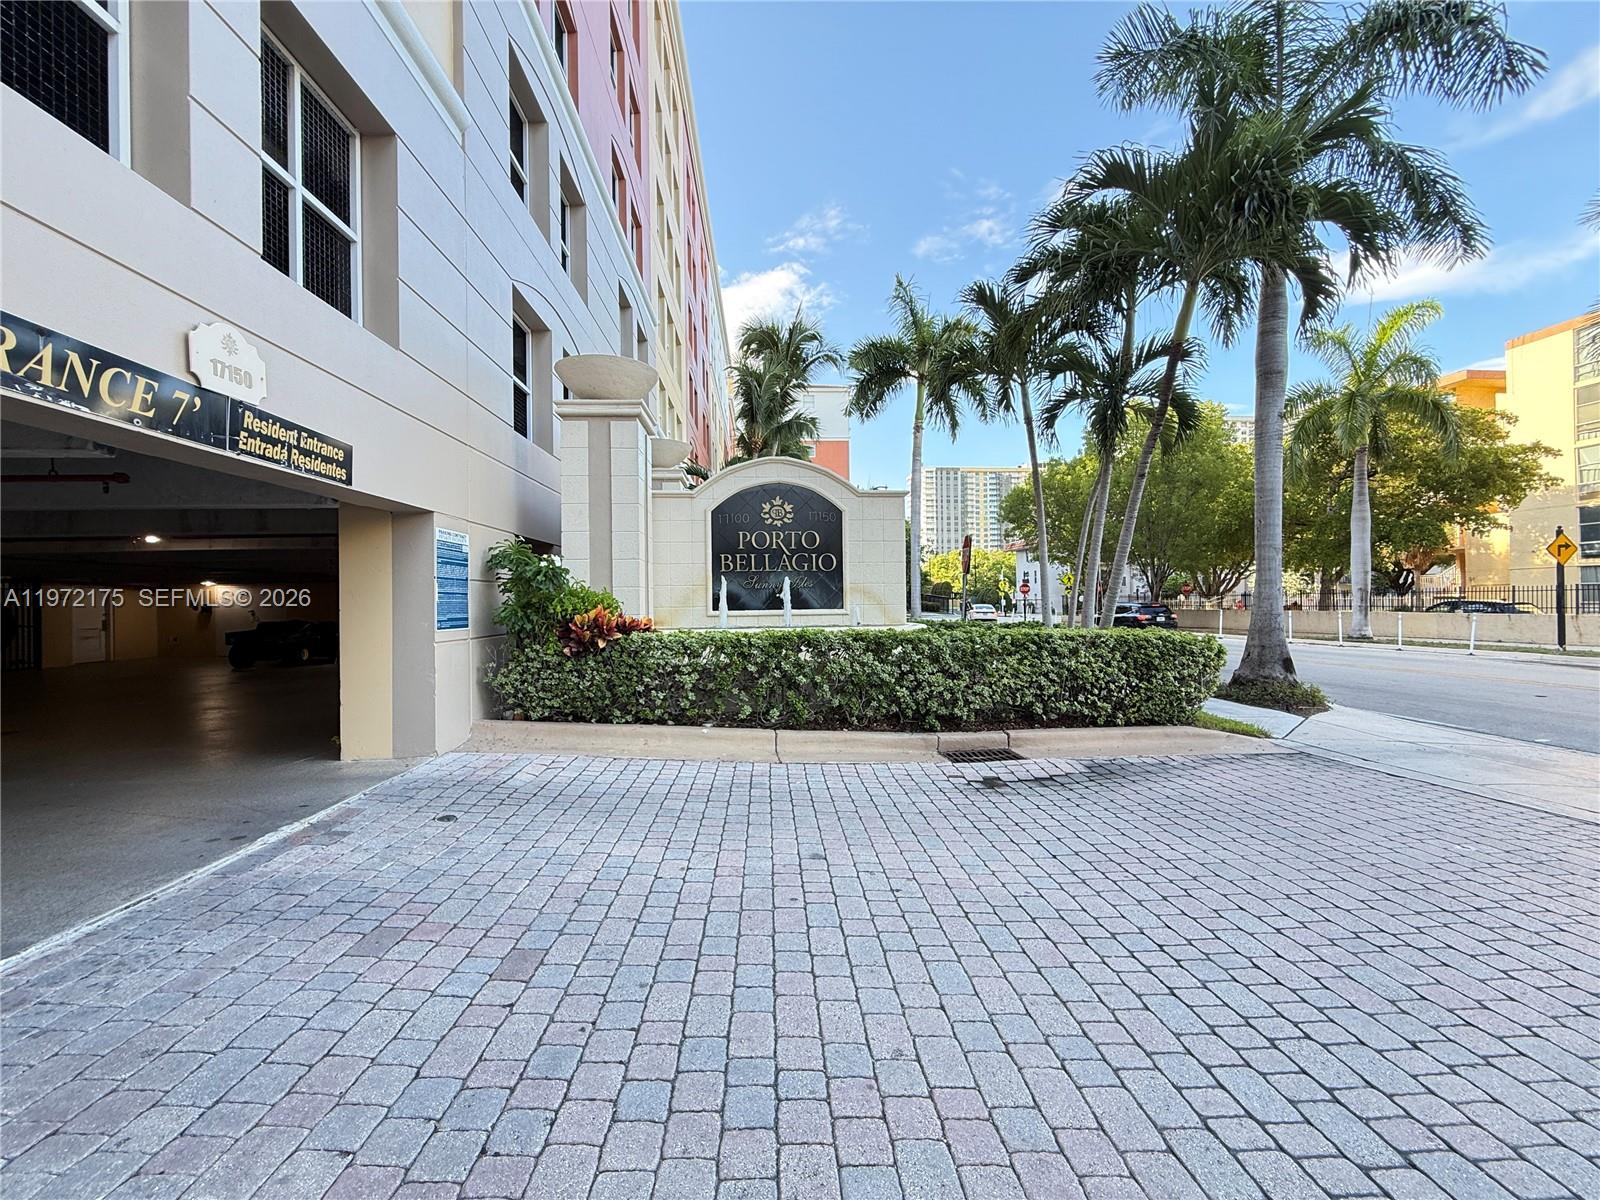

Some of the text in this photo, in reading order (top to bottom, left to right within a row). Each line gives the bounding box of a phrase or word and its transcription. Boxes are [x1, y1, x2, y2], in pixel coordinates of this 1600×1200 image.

[209, 357, 254, 390] 17150
[243, 410, 345, 461] Resident Entrance
[238, 431, 347, 480] Entrada Residentes
[718, 513, 750, 524] 17100
[737, 530, 820, 555] PORTO
[719, 553, 837, 572] BELLAGIO
[743, 575, 783, 593] Sunny
